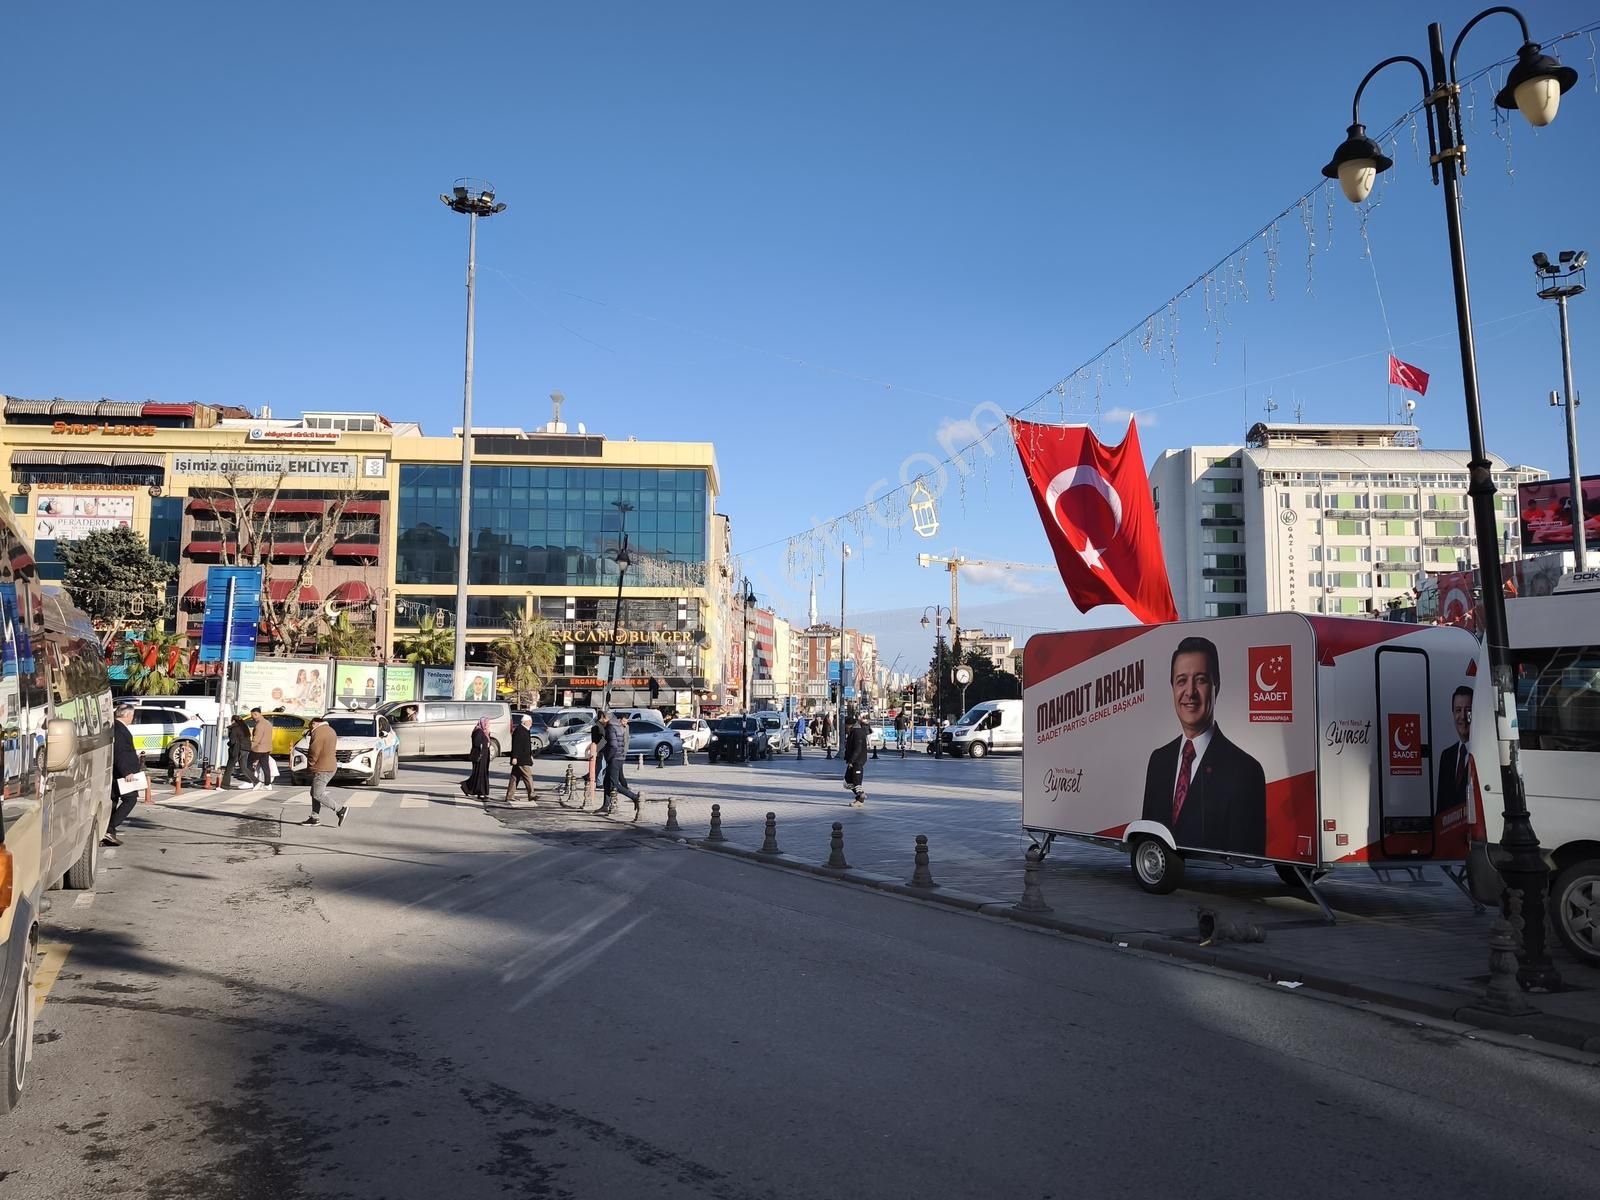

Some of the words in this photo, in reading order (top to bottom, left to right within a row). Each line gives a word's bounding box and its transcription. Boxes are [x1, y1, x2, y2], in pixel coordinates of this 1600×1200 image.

[175, 458, 217, 474] işimiz
[220, 460, 282, 474] gücümüz
[72, 483, 139, 491] RESTAURANT
[551, 630, 609, 643] ERCAN
[629, 630, 692, 643] BURGER
[570, 678, 596, 686] ERCAN
[1037, 682, 1092, 733] MAHMUT
[1095, 659, 1145, 709] ARIKAN
[1253, 692, 1288, 702] SAADET
[1037, 727, 1062, 744] SAADET
[1088, 709, 1111, 723] GENEL
[1112, 693, 1145, 713] BAŞKANI
[1325, 720, 1372, 755] Siyaset
[1392, 751, 1418, 759] SAADET
[1043, 768, 1084, 802] Siyaset
